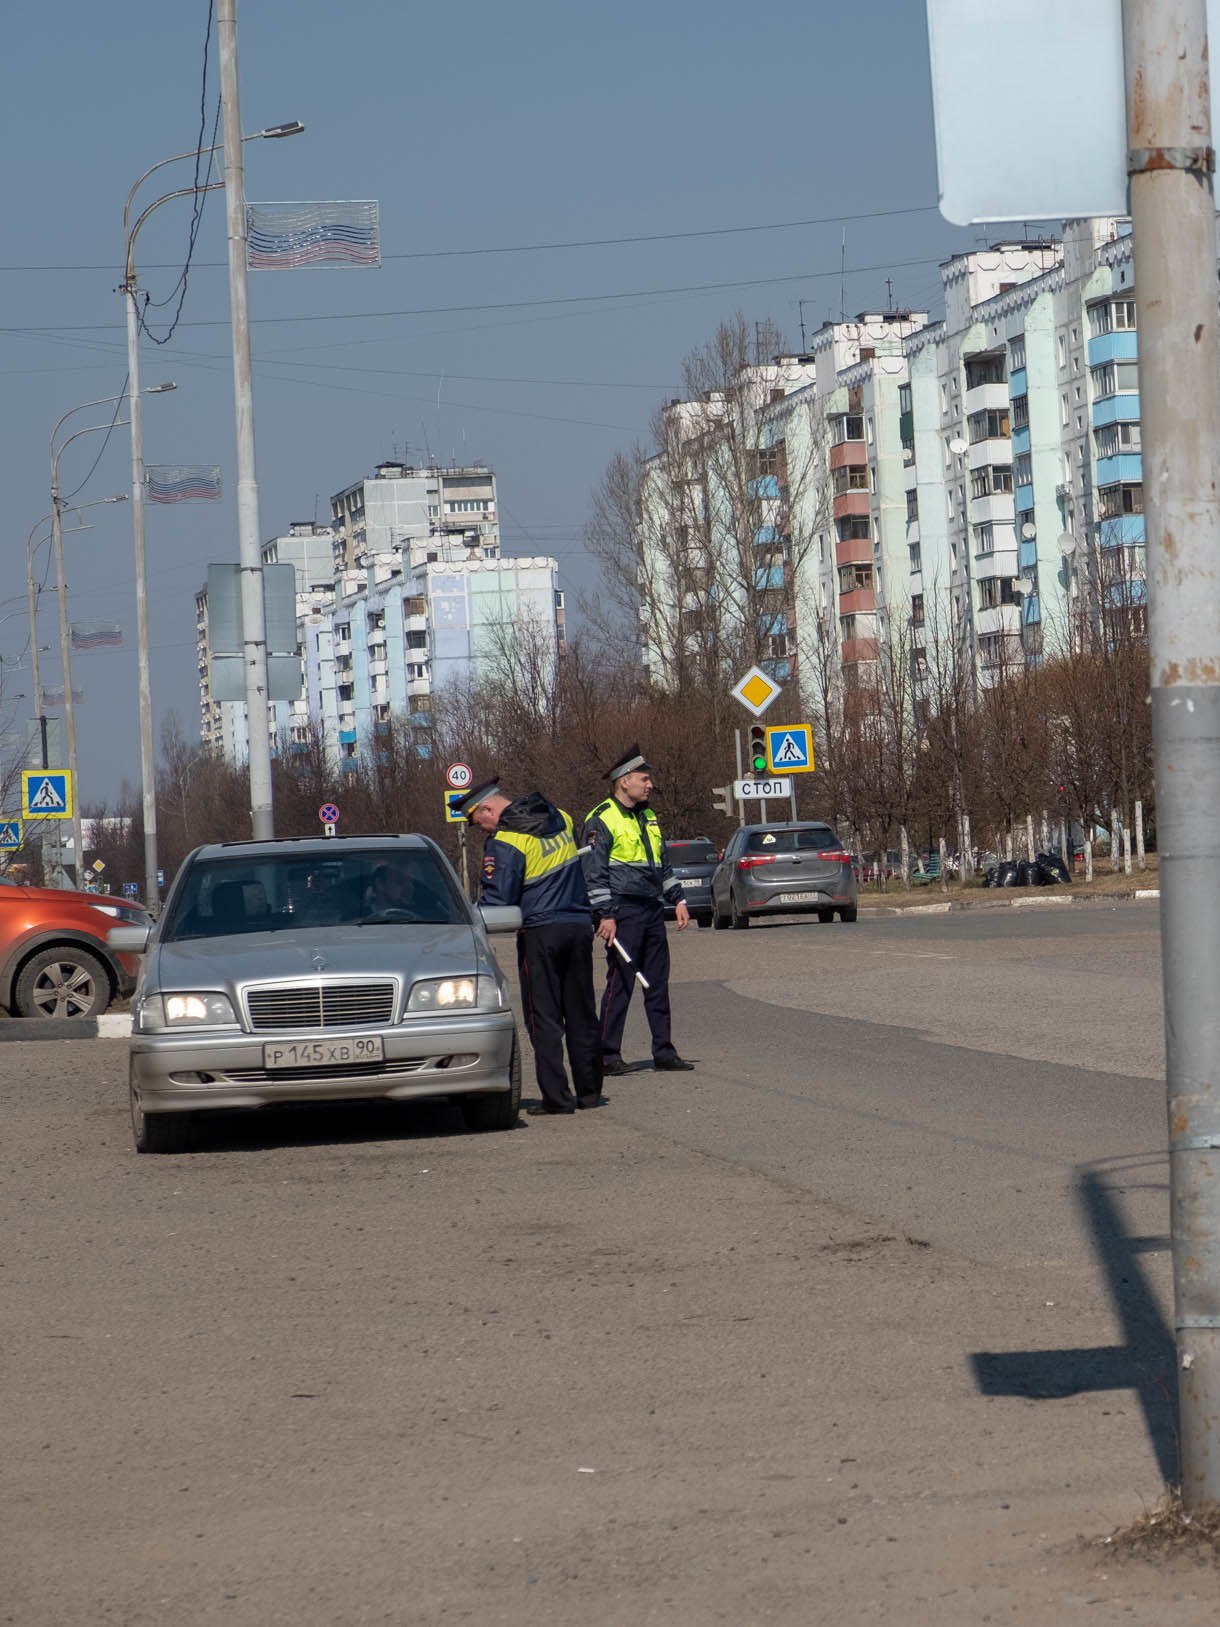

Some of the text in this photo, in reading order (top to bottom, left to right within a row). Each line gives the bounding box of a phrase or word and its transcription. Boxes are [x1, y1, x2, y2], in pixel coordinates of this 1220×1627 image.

[451, 770, 467, 781] 40
[742, 782, 783, 795] СТОП
[356, 1039, 375, 1055] 90
